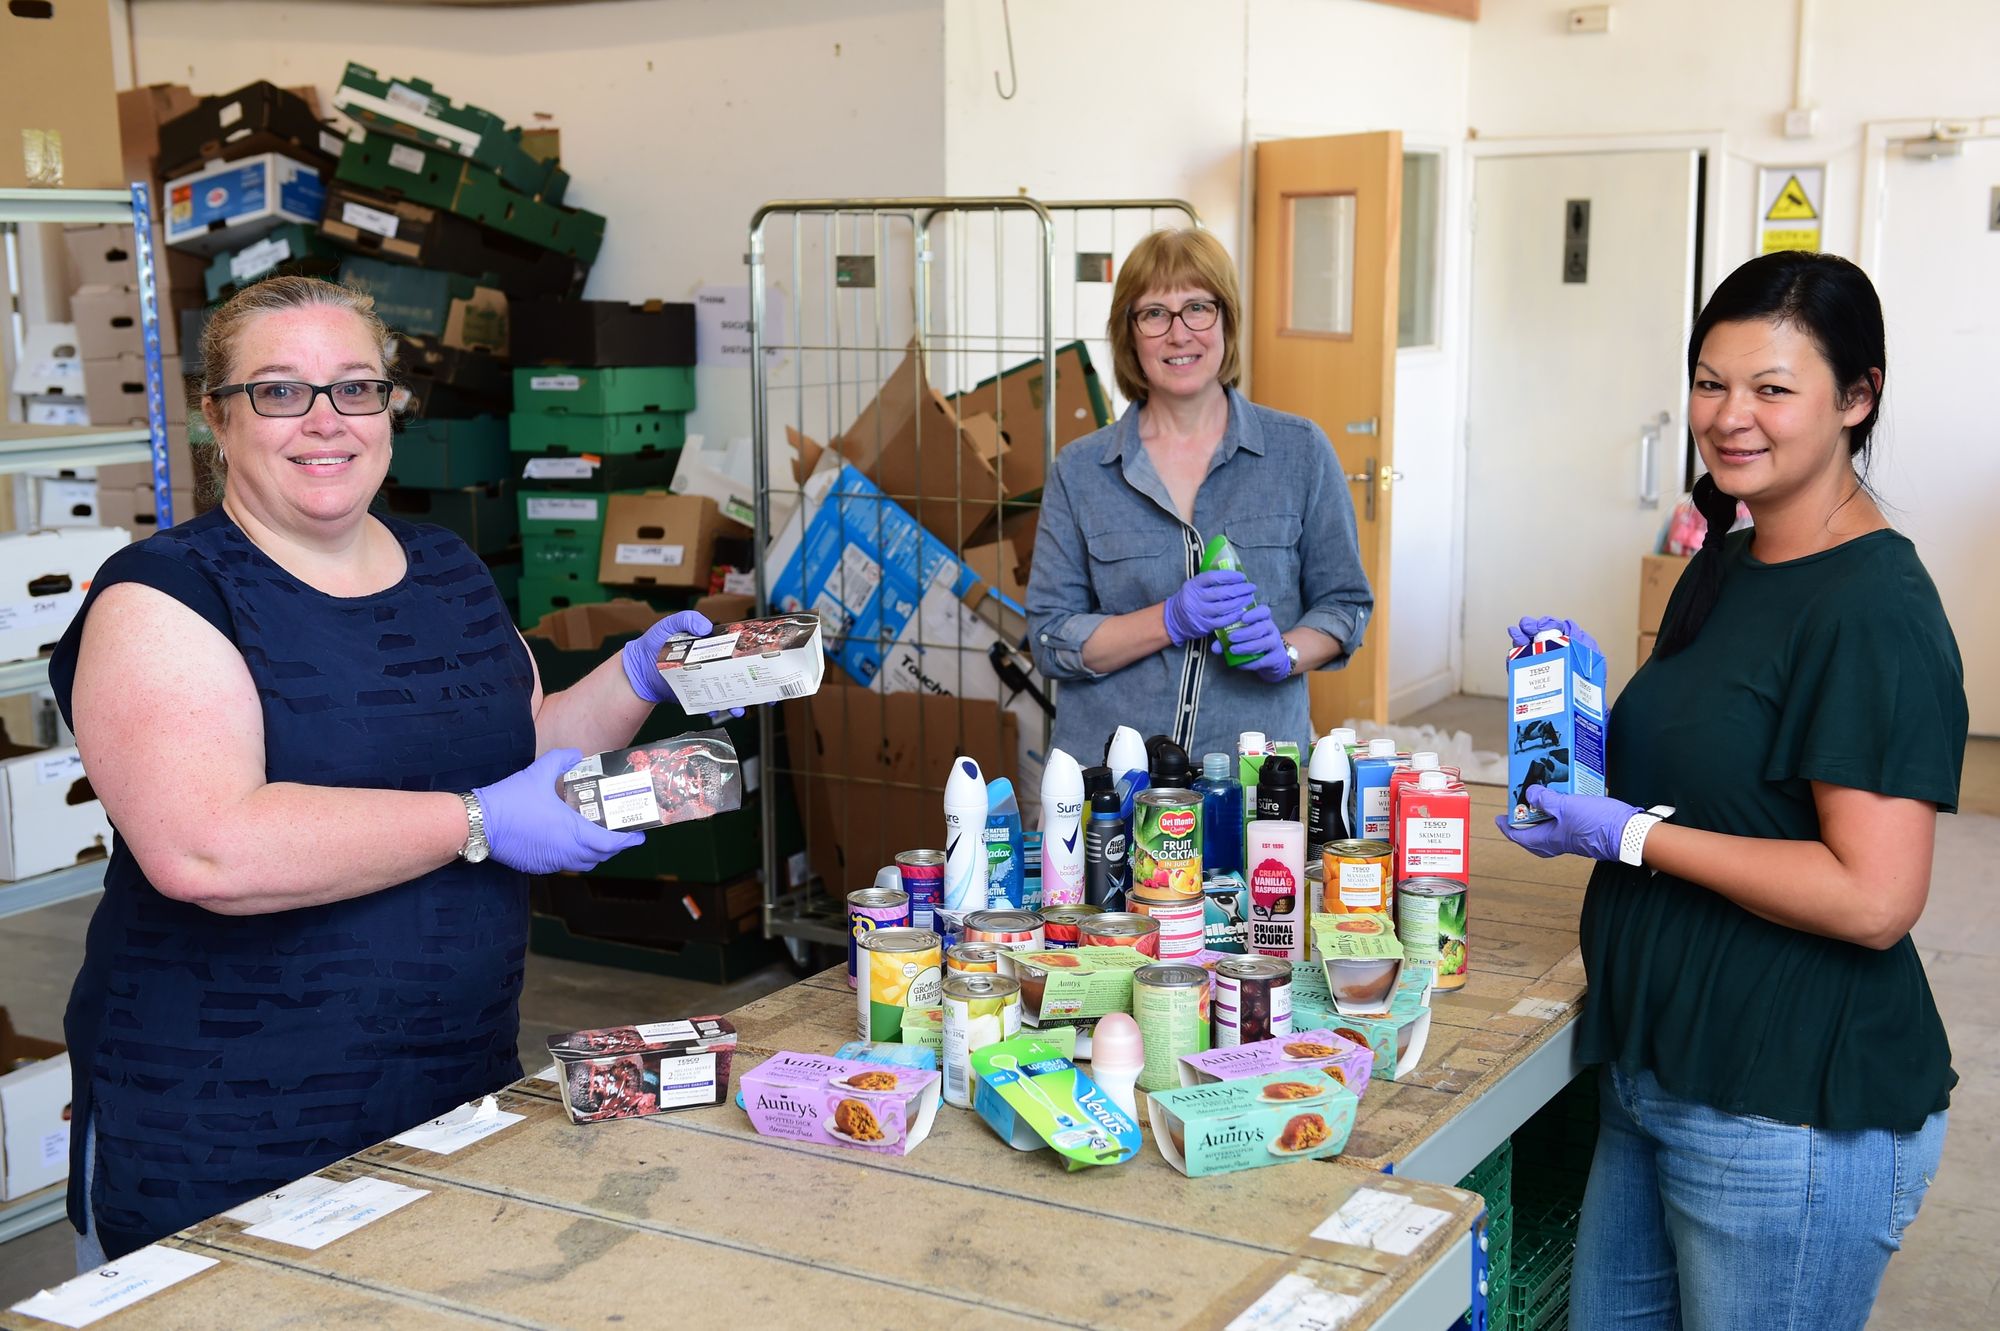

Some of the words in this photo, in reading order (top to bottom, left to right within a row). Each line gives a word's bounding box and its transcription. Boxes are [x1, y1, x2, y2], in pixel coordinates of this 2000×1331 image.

[1529, 665, 1550, 677] TESCO
[1528, 677, 1550, 686] WHOLE
[1057, 802, 1082, 814] Sure
[1174, 817, 1194, 826] Monte
[1423, 821, 1448, 829] TESCO
[1163, 840, 1192, 850] FRUIT
[987, 848, 1011, 858] adox
[1151, 848, 1199, 860] COCKTAIL
[1063, 864, 1079, 872] bright
[1259, 869, 1288, 878] CREAMY
[1254, 877, 1285, 887] VANILLA
[1285, 877, 1293, 887] &
[1254, 886, 1292, 895] RASPBERRY
[1205, 922, 1249, 937] illett
[1253, 924, 1294, 935] ORIGINAL
[1205, 934, 1246, 945] MACH3
[1253, 933, 1294, 946] SOURCE
[677, 1057, 700, 1066] TESCO
[1201, 1049, 1272, 1067] Aunty's
[773, 1057, 847, 1073] Aunty's
[1027, 1058, 1064, 1071] smooth
[667, 1071, 674, 1080] 2
[1171, 1087, 1249, 1104] Aunty's
[757, 1094, 818, 1118] Aunty's
[1079, 1087, 1126, 1135] Venus
[765, 1115, 795, 1125] SPOTTED
[795, 1119, 812, 1127] DICK
[1198, 1127, 1265, 1151] Aunty's
